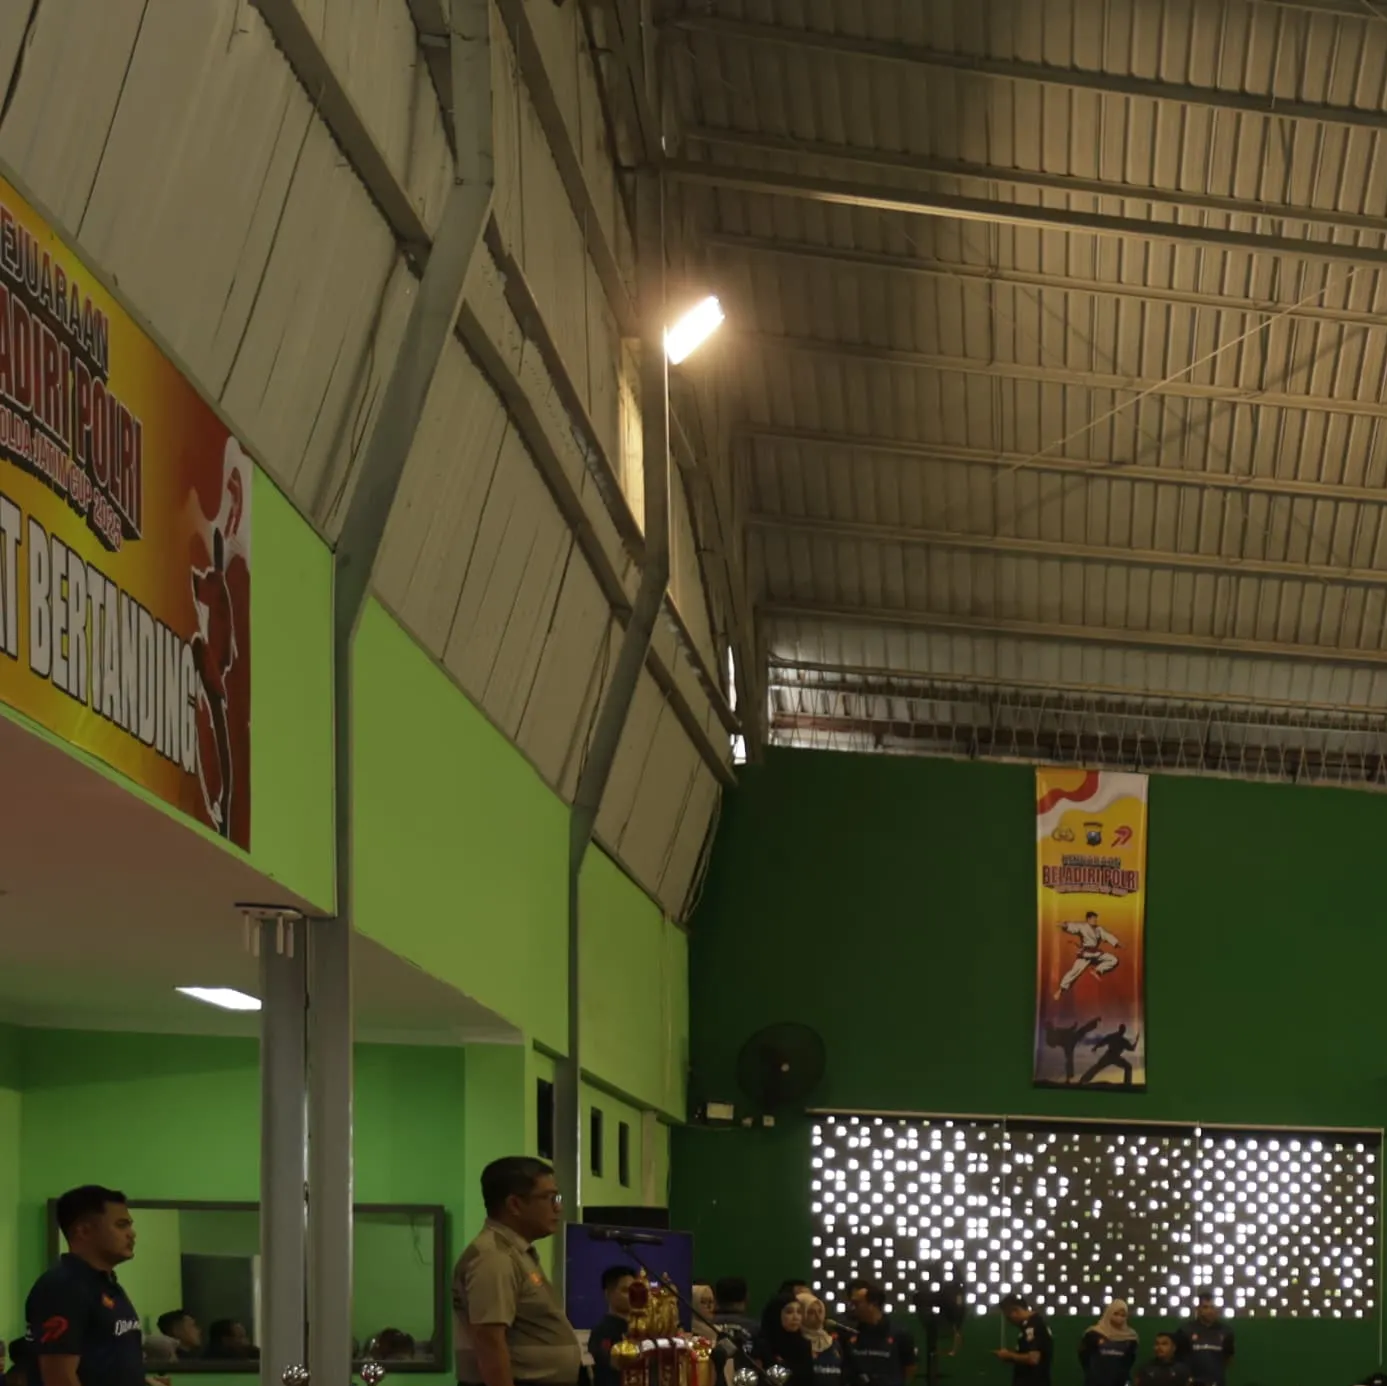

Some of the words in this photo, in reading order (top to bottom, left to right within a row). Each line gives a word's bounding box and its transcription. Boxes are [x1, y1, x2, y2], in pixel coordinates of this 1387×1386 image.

[0, 206, 109, 379] EJUARAAN
[0, 281, 72, 452] ADIRI
[74, 356, 143, 540] POLRI
[0, 404, 33, 463] OLDA
[33, 427, 69, 492] JATIM
[69, 458, 92, 513] CUP
[92, 486, 121, 552] 2025
[28, 514, 198, 774] BERTANDING
